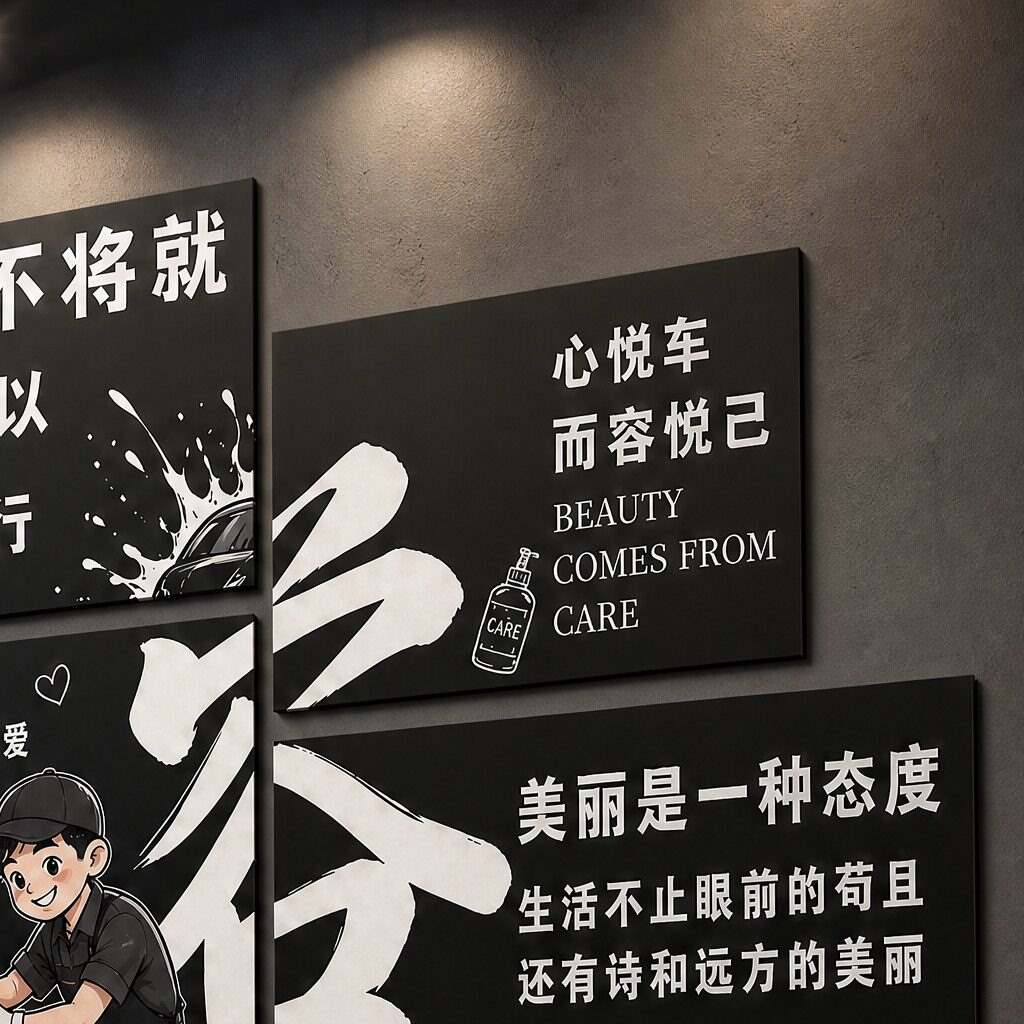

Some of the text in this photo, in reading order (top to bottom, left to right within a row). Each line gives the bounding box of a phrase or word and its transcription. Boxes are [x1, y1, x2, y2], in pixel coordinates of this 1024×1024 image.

[551, 315, 710, 389] 心悦车
[552, 391, 770, 474] 而容悦己
[553, 487, 684, 533] BEAUTY
[553, 529, 777, 585] COMES FROM
[486, 616, 522, 641] CARE
[553, 598, 639, 637] CARE
[517, 742, 941, 846] 美丽是一种态度
[518, 858, 924, 934] 生活不止眼前的苟且
[518, 933, 924, 1006] 还有诗和远方的美丽
